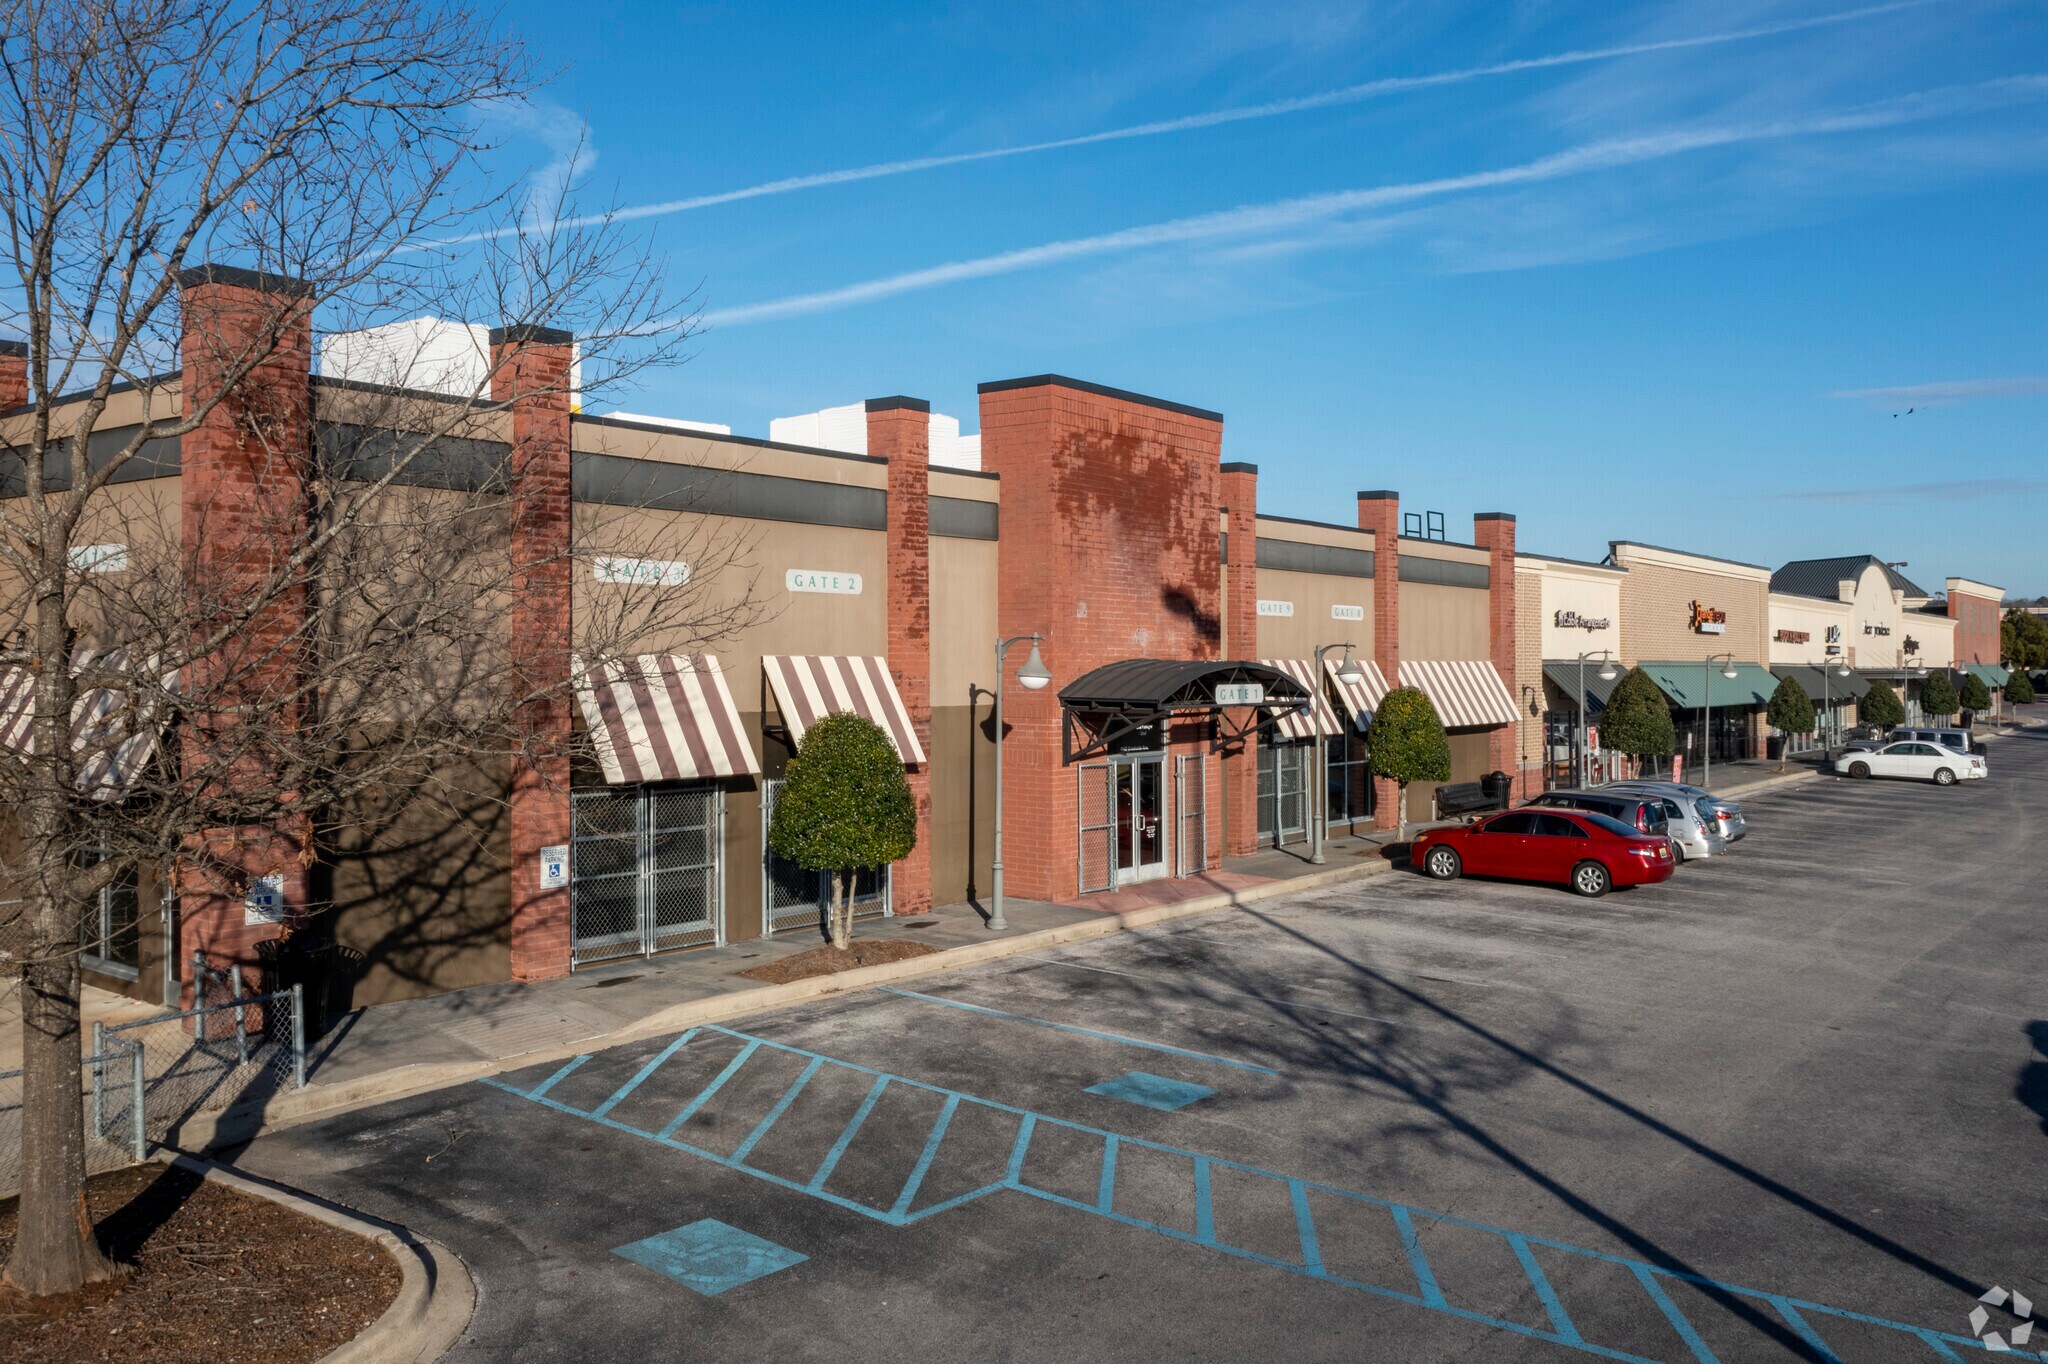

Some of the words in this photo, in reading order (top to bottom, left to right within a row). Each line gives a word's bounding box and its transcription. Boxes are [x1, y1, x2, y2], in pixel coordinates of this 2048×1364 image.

[604, 563, 661, 579] GATE
[673, 567, 681, 581] 3
[794, 574, 839, 589] GATE
[848, 577, 855, 590] 2
[1260, 603, 1283, 613] GATE
[1286, 605, 1291, 614] 9
[1334, 607, 1354, 617] GATE
[1220, 689, 1249, 700] GATE
[1254, 689, 1258, 699] 1
[542, 848, 567, 857] RESERVED
[544, 856, 565, 864] PARKING
